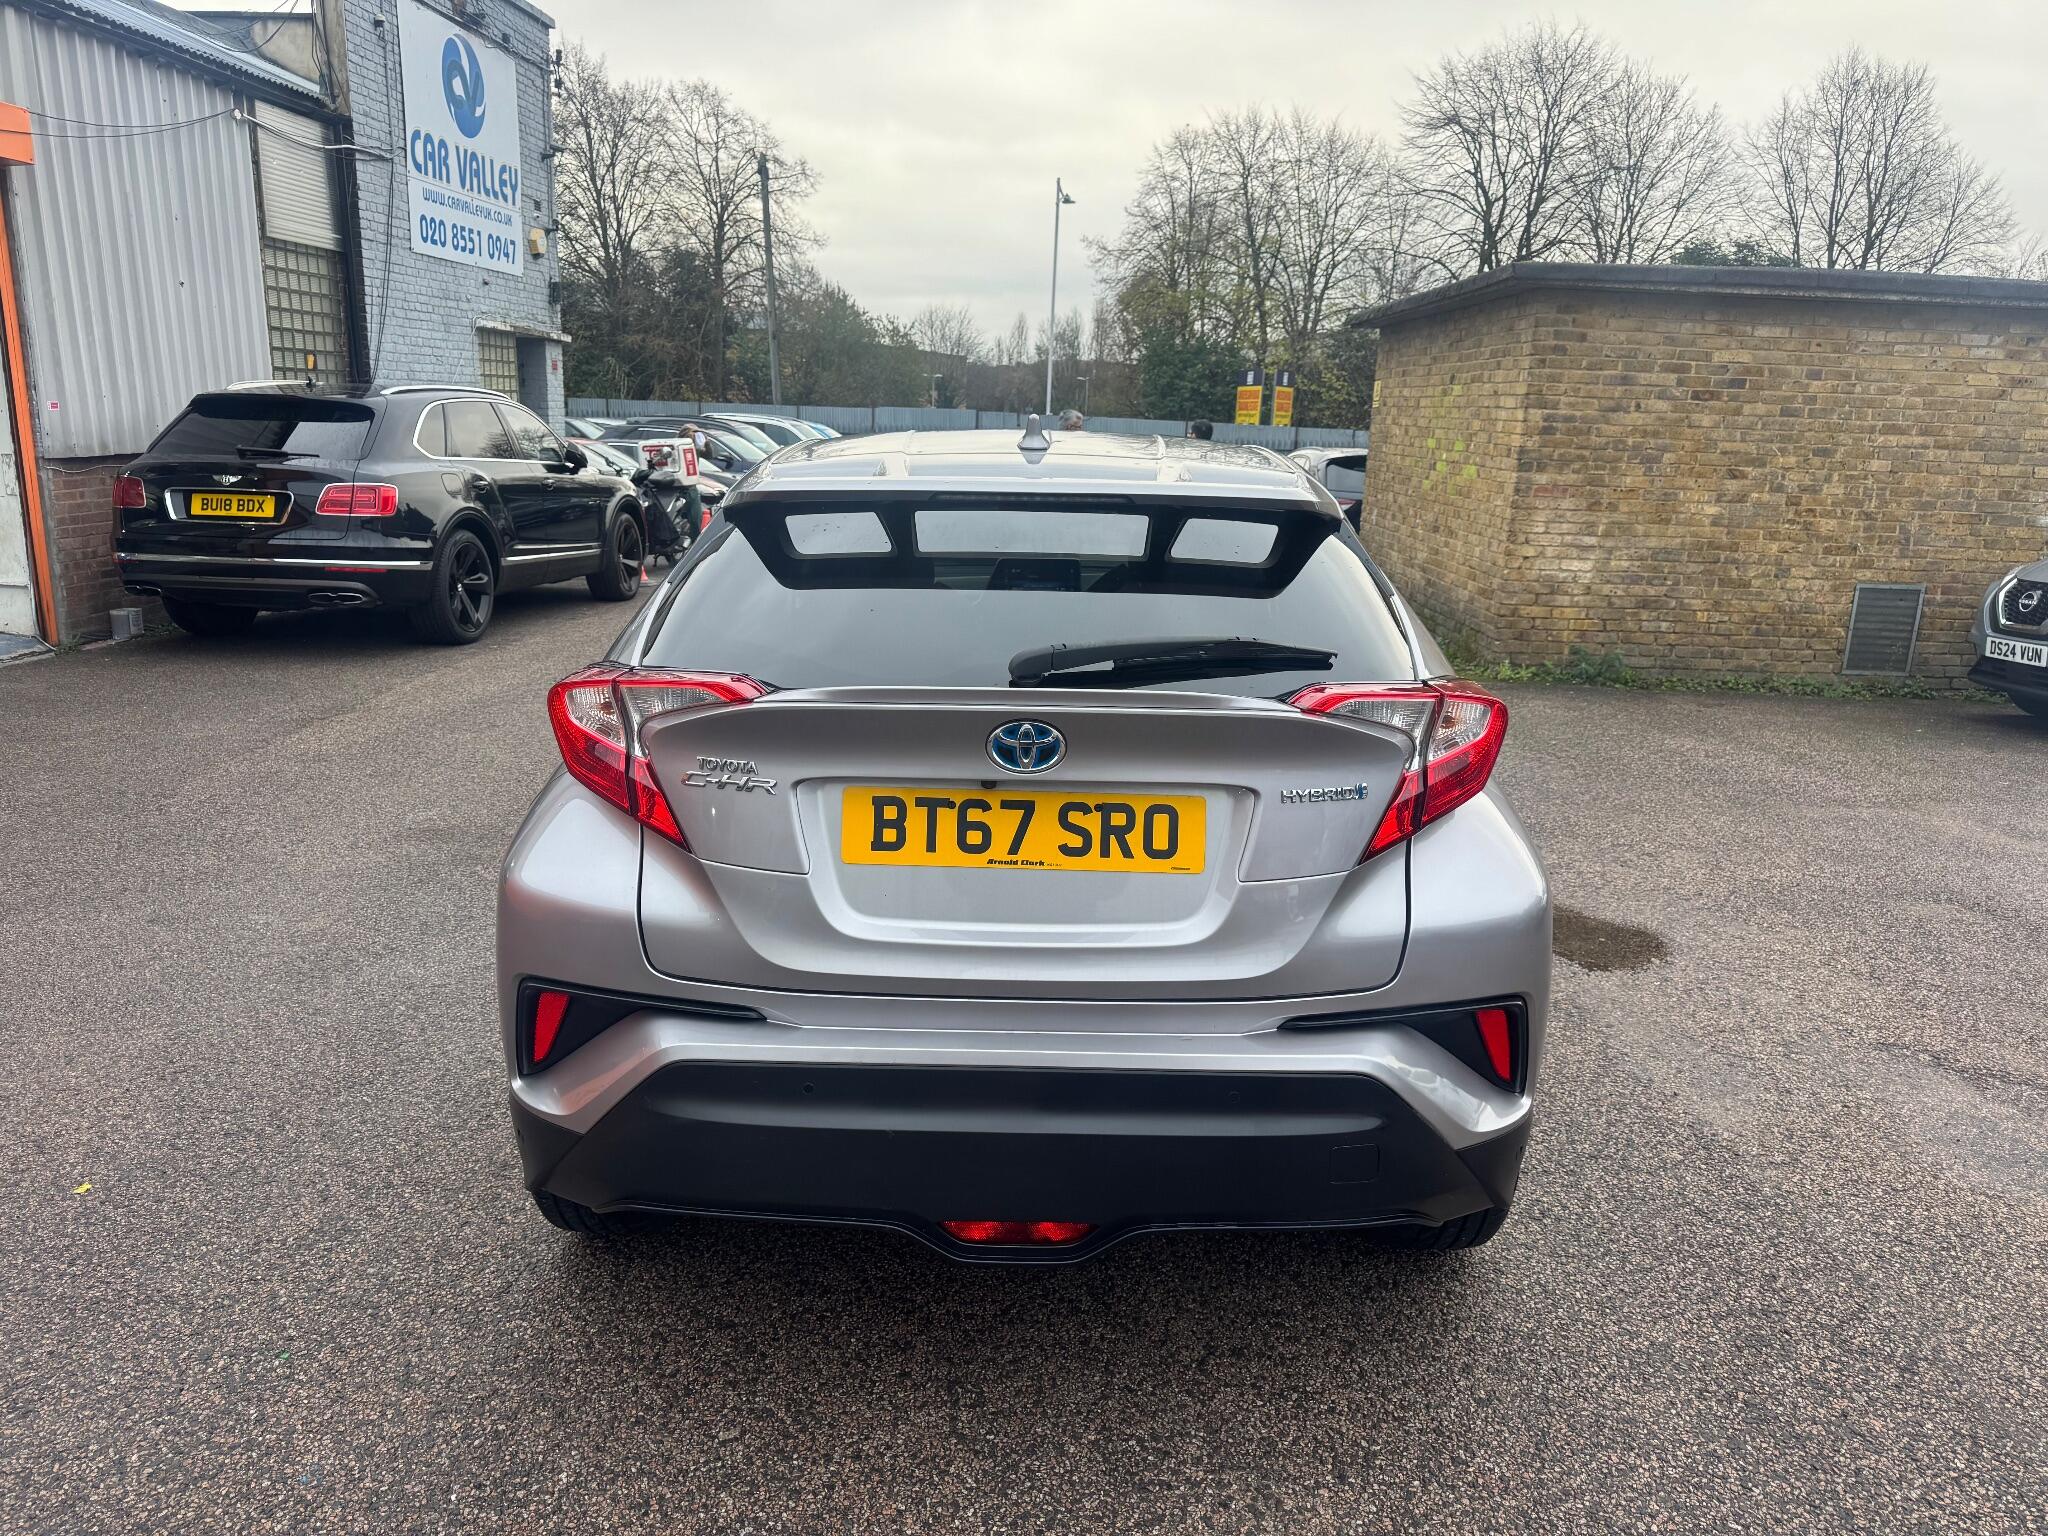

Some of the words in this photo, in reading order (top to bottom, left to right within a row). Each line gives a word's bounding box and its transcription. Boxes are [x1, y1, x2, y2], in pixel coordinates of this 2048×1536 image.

[410, 129, 451, 184] CAR
[455, 145, 519, 206] VALLEY
[422, 186, 513, 227] WWW.CARVALLEYUK.CO.UK
[420, 214, 447, 248] 020
[451, 222, 482, 257] 8551
[487, 233, 516, 264] 0947
[201, 497, 232, 511] BU18
[236, 498, 265, 513] BDX
[1990, 641, 2017, 658] DS24
[2020, 646, 2043, 663] VUN
[696, 756, 759, 775] TOYOTA
[681, 770, 777, 795] C-HR
[1280, 786, 1356, 803] HYBRID
[870, 795, 1036, 856] BT67
[1057, 801, 1179, 860] SRO
